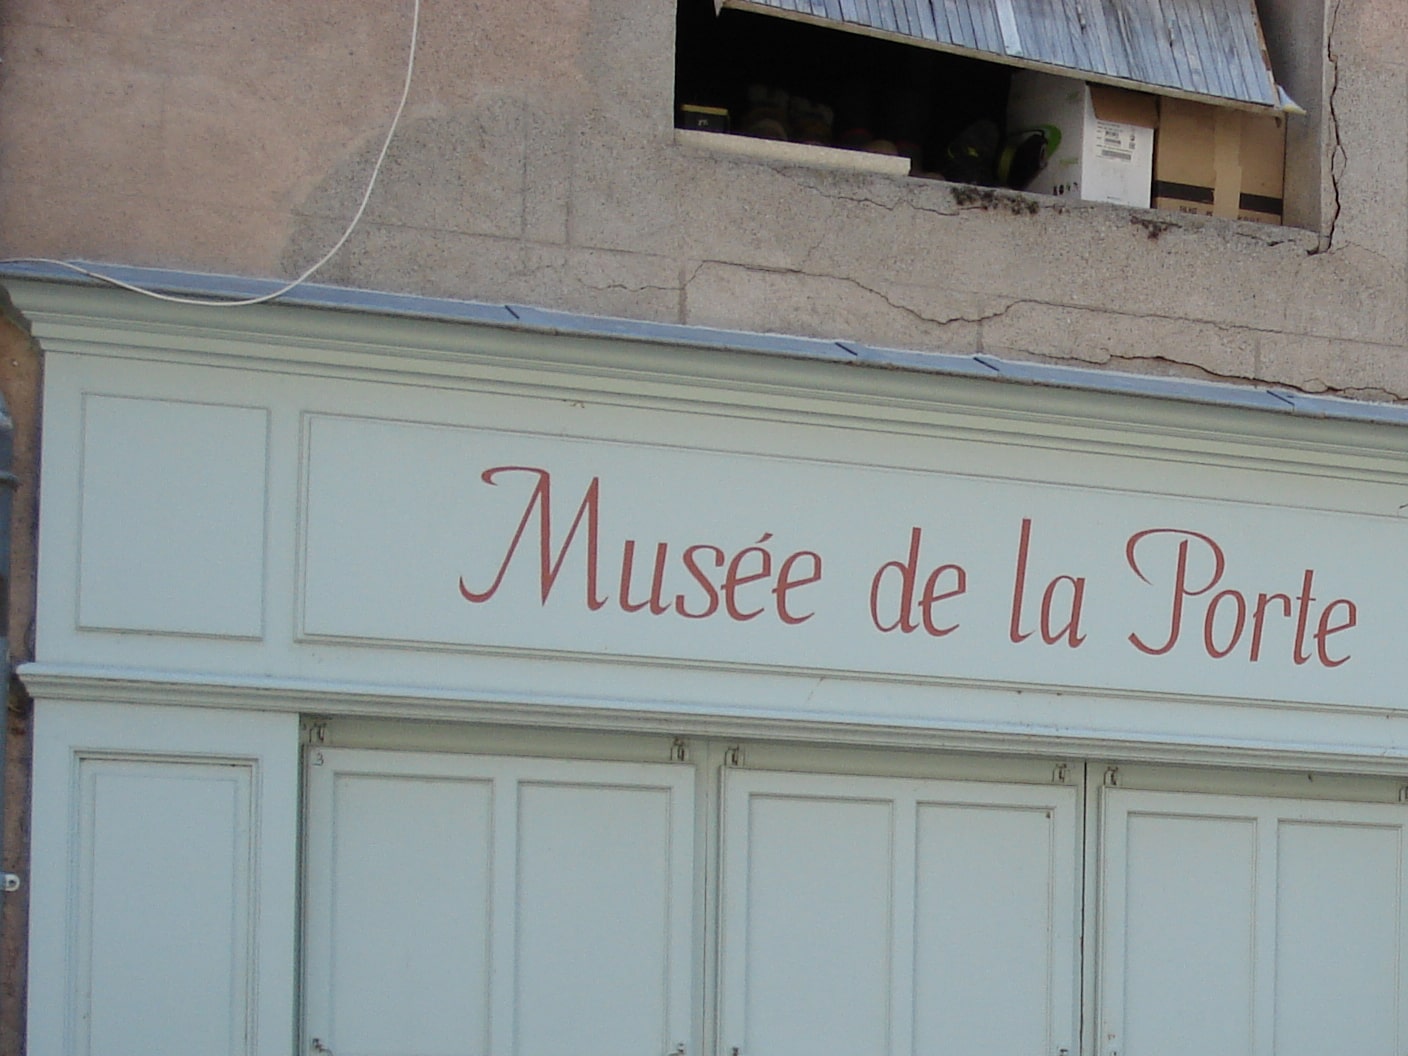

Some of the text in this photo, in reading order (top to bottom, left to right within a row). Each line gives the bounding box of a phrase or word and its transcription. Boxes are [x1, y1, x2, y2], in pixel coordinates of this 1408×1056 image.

[459, 466, 1358, 669] Musée de la Porte
